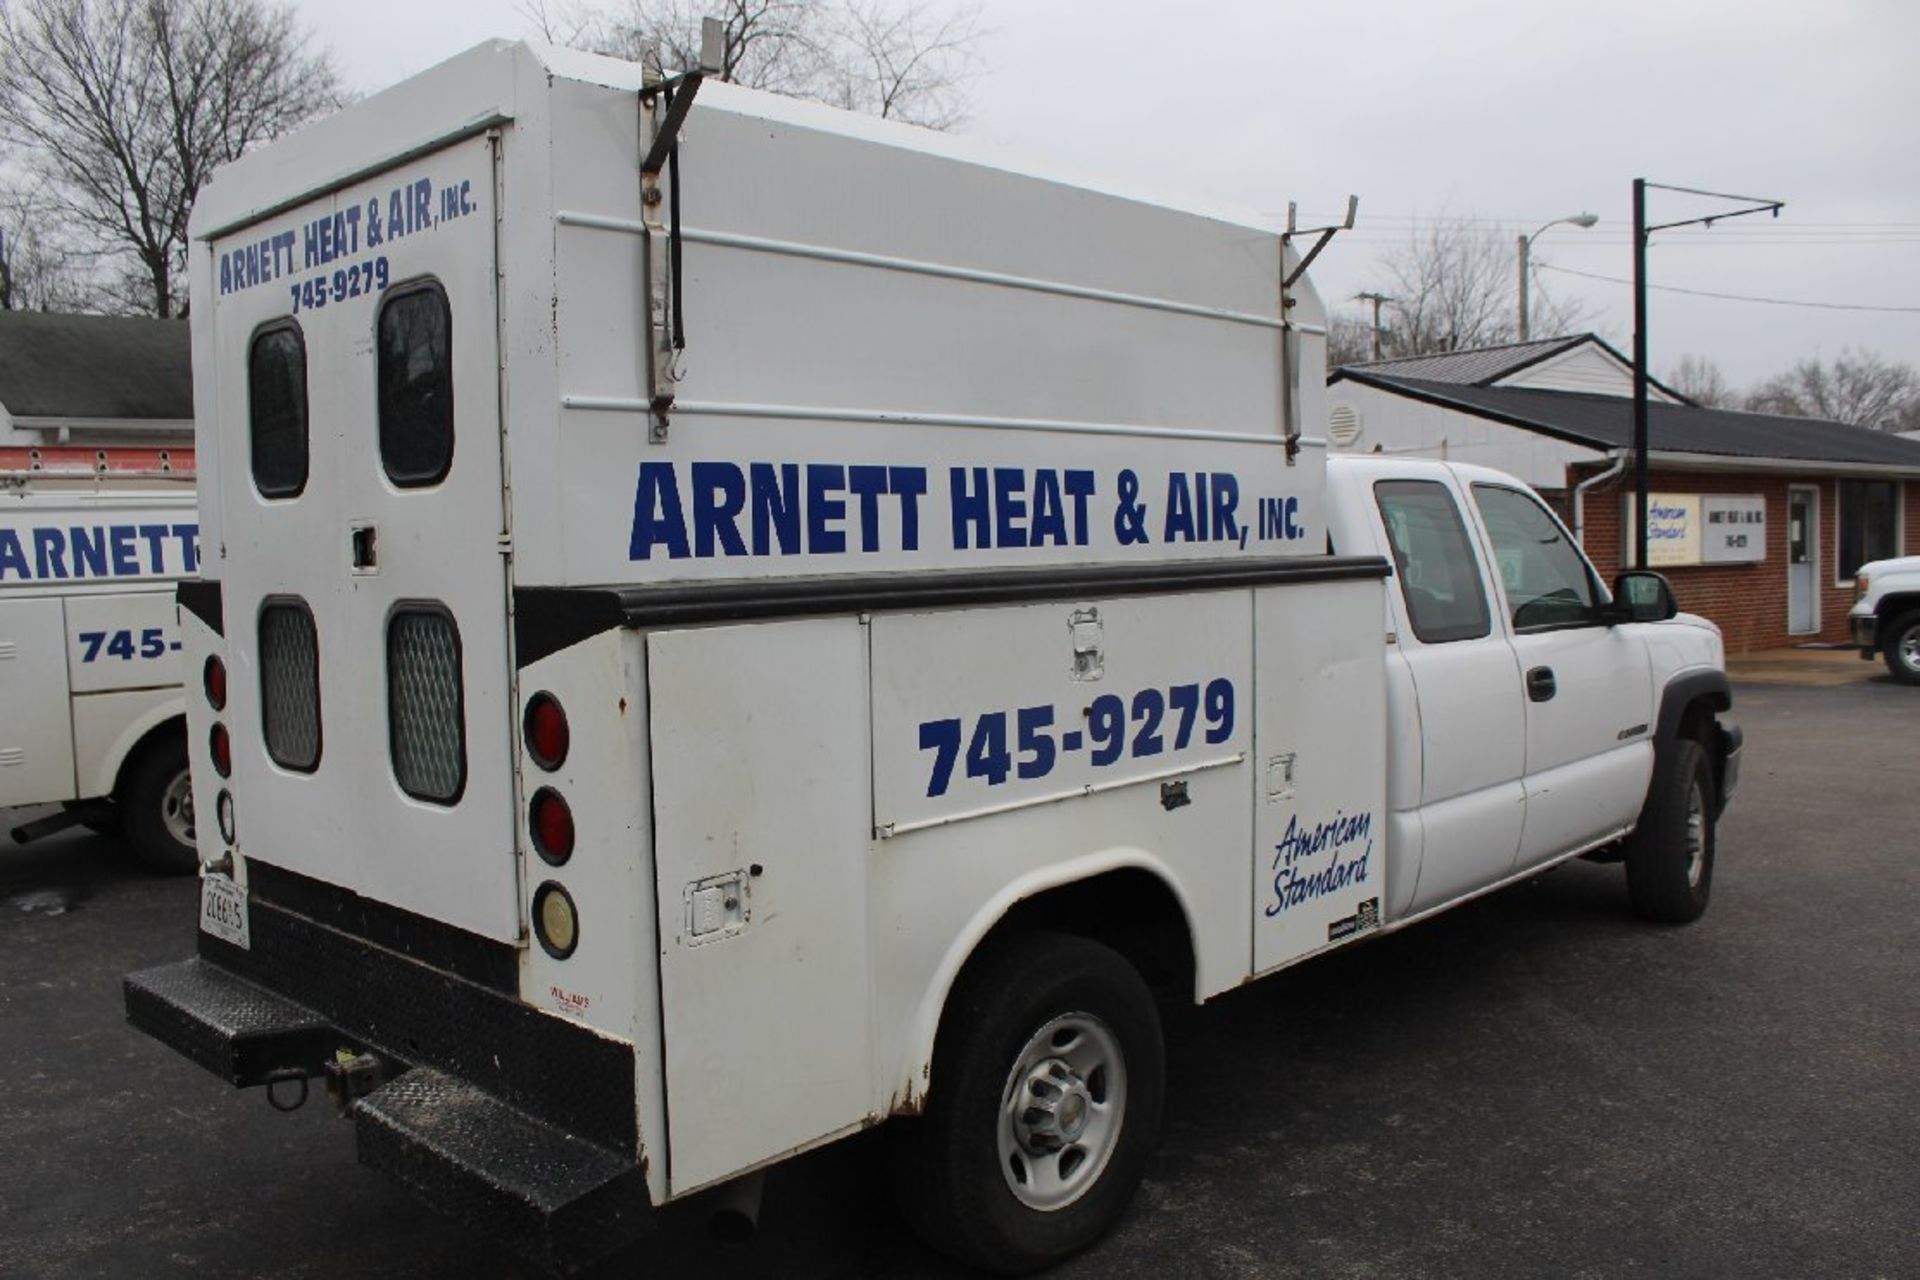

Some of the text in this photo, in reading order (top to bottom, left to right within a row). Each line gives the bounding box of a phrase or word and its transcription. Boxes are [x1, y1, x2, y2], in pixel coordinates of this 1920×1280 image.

[220, 177, 478, 295] ARNETT HEAT & AIR, INC.
[291, 256, 389, 314] 745-9279
[629, 462, 1304, 561] ARNETT HEAT & AIR, INC.
[0, 524, 199, 580] ARNETT
[79, 628, 182, 663] 745-
[918, 677, 1235, 798] 745-9279
[1272, 809, 1371, 870] American
[1265, 839, 1373, 917] Standard
